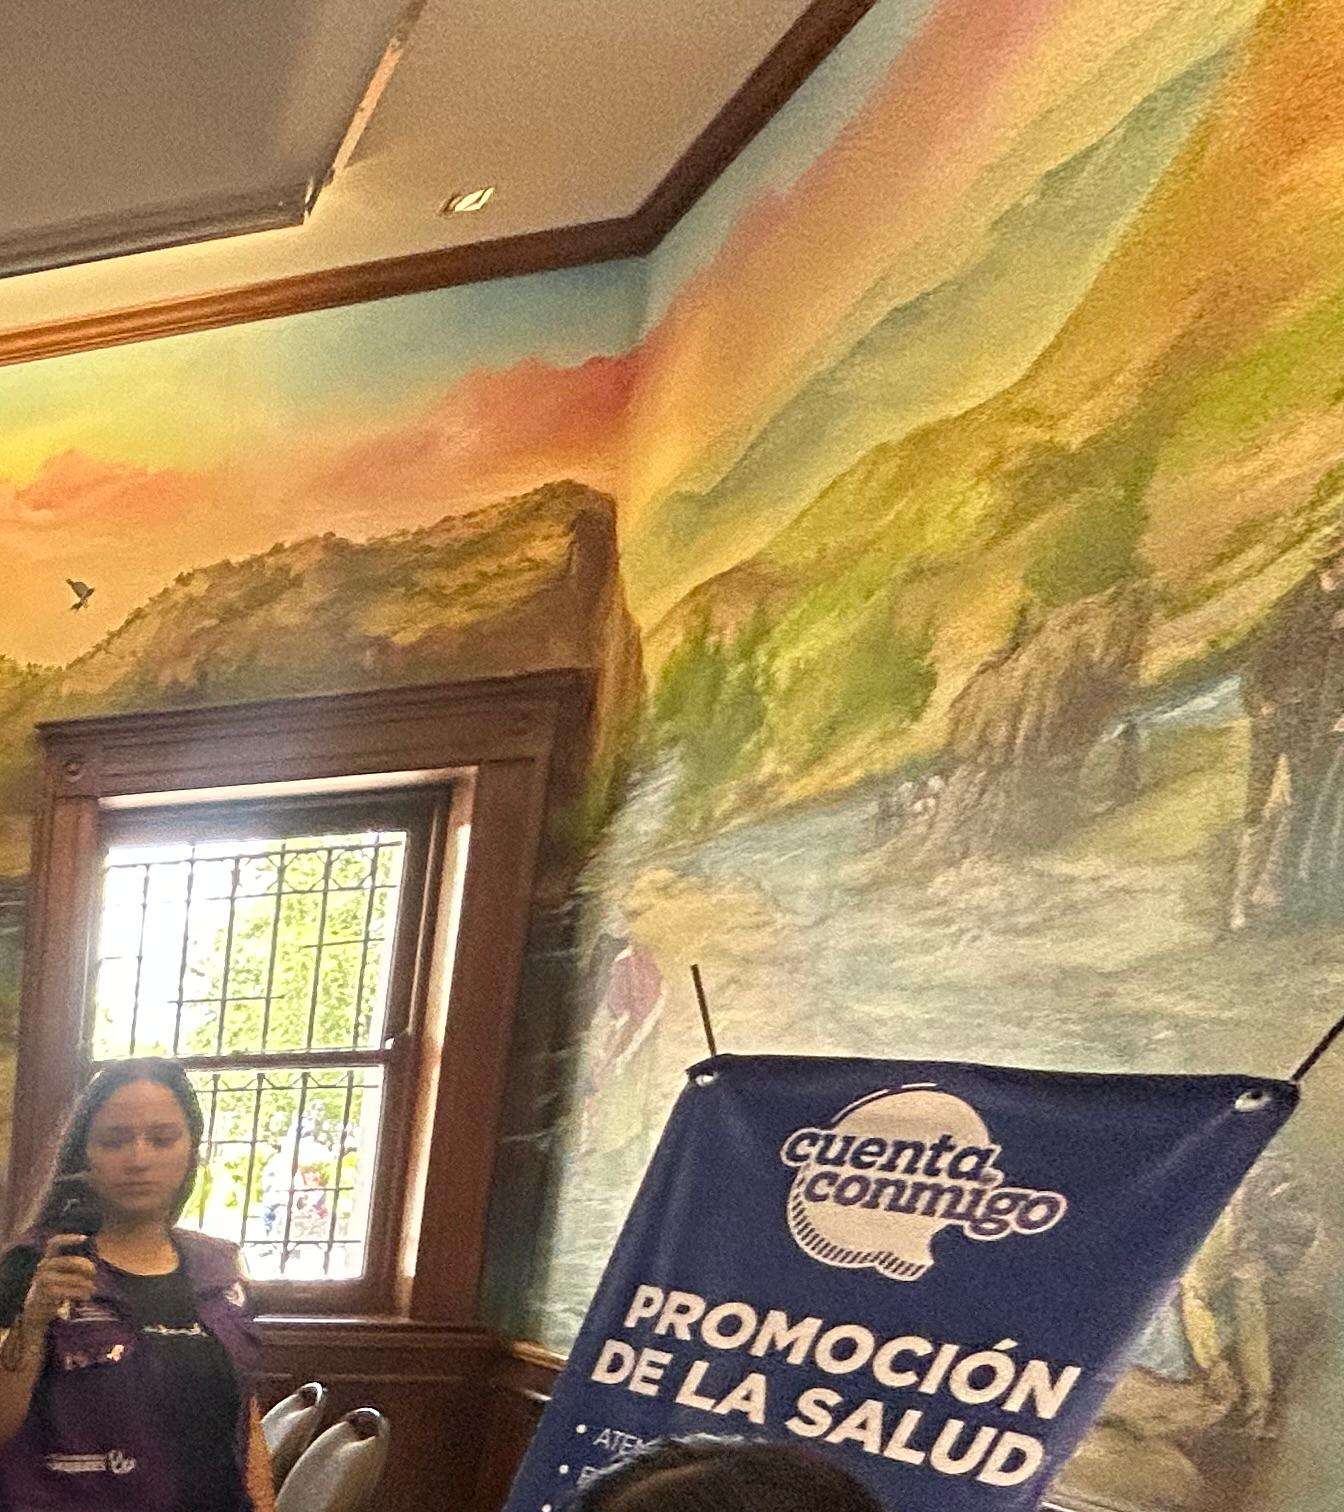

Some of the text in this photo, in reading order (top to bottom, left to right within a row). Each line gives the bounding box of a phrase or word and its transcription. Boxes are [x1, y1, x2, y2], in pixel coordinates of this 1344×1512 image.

[785, 1131, 997, 1181] cuenta
[804, 1169, 1062, 1237] conmigo
[624, 1284, 1081, 1420] PROMOCIÓN
[591, 1340, 1045, 1487] DE LA SALUD
